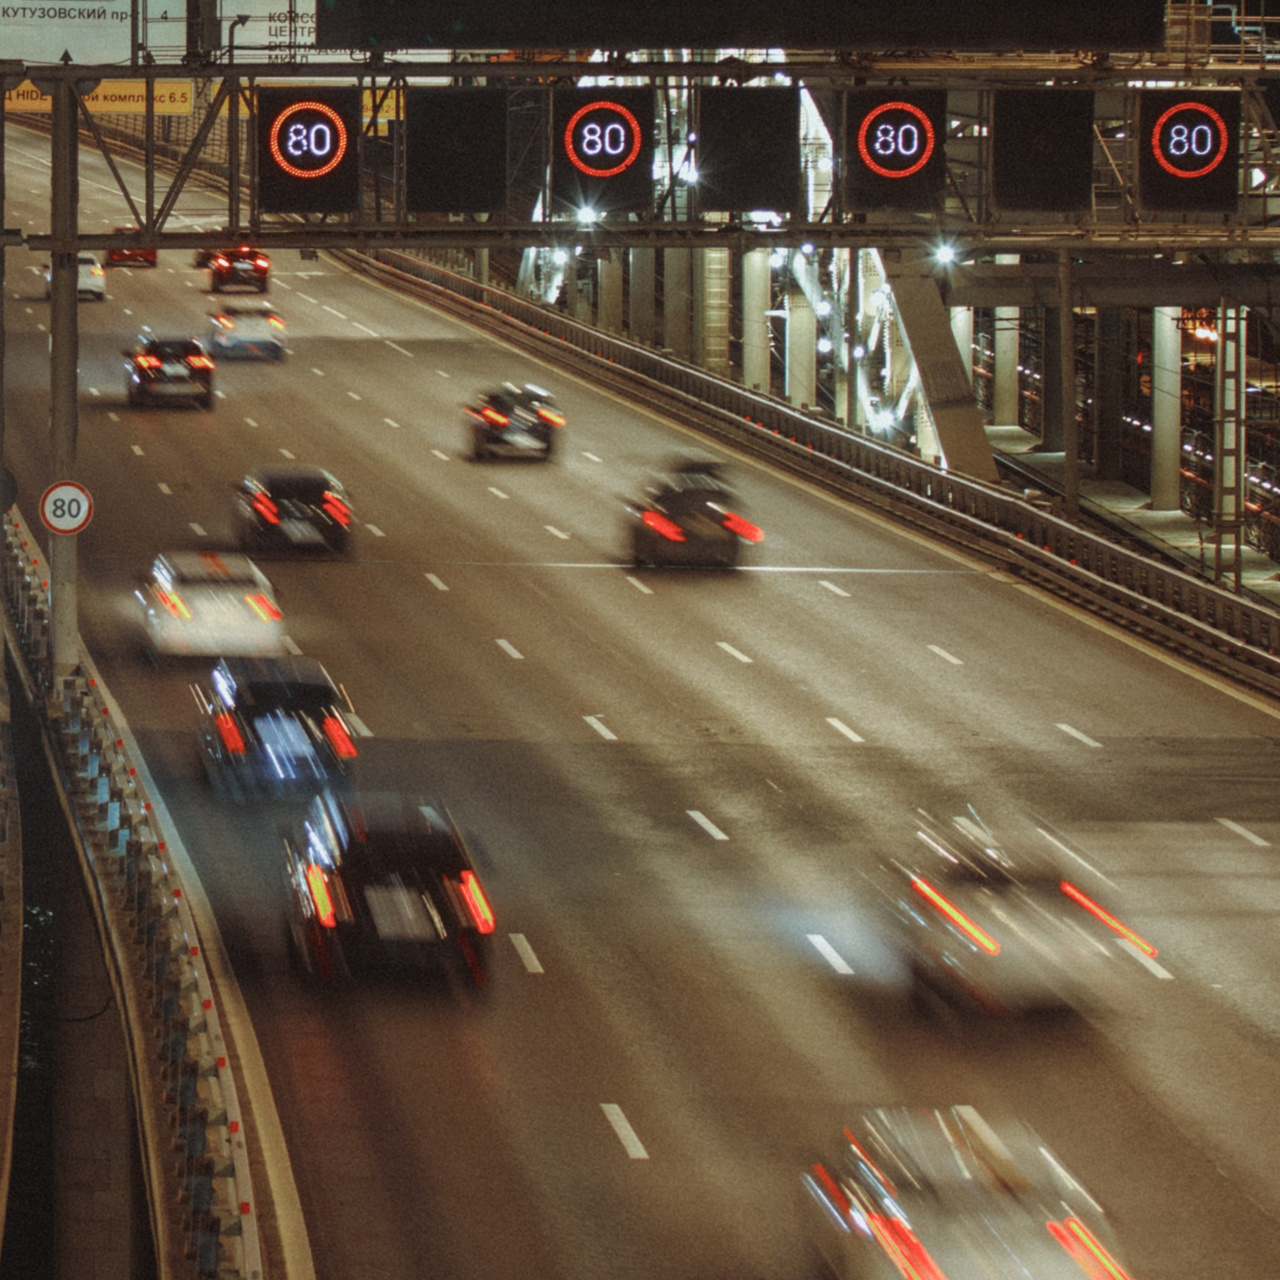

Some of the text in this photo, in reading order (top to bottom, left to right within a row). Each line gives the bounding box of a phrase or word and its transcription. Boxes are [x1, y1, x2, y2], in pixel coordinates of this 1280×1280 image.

[2, 6, 107, 20] КУТУЗОВСКИЙ
[168, 91, 188, 104] 6.5
[287, 123, 331, 157] 80
[581, 123, 625, 157] 80
[874, 123, 919, 157] 80
[1168, 123, 1213, 158] 80
[52, 498, 81, 518] 80
